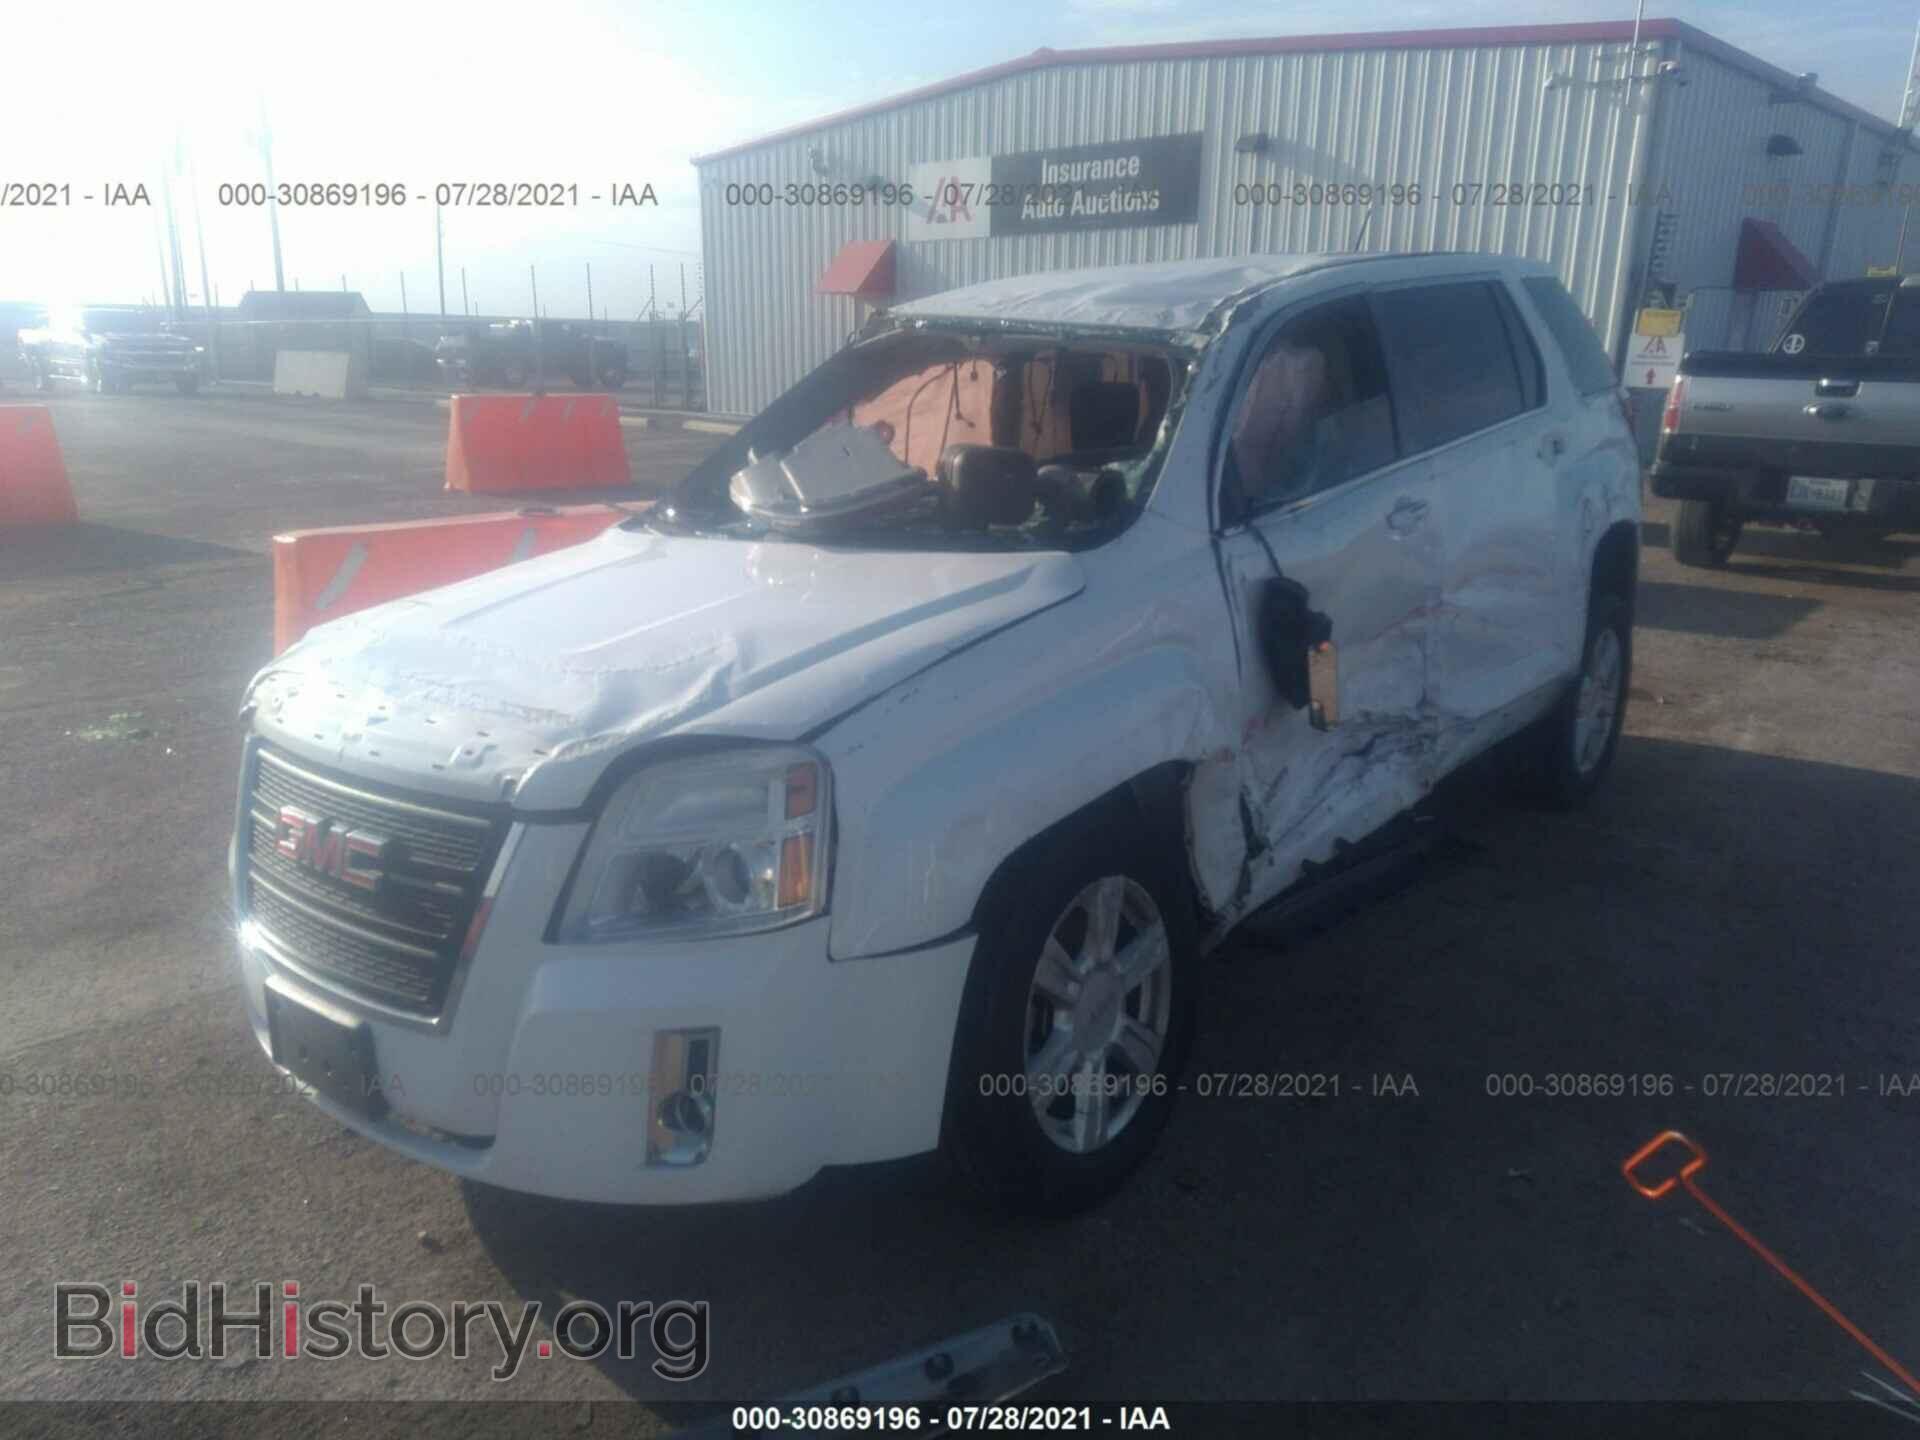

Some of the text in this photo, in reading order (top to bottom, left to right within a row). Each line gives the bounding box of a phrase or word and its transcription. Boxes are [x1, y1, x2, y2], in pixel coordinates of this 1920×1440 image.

[1042, 155, 1140, 184] Insurance
[1021, 194, 1065, 220] Auto
[1070, 187, 1160, 217] Auctions
[274, 805, 389, 889] GMC
